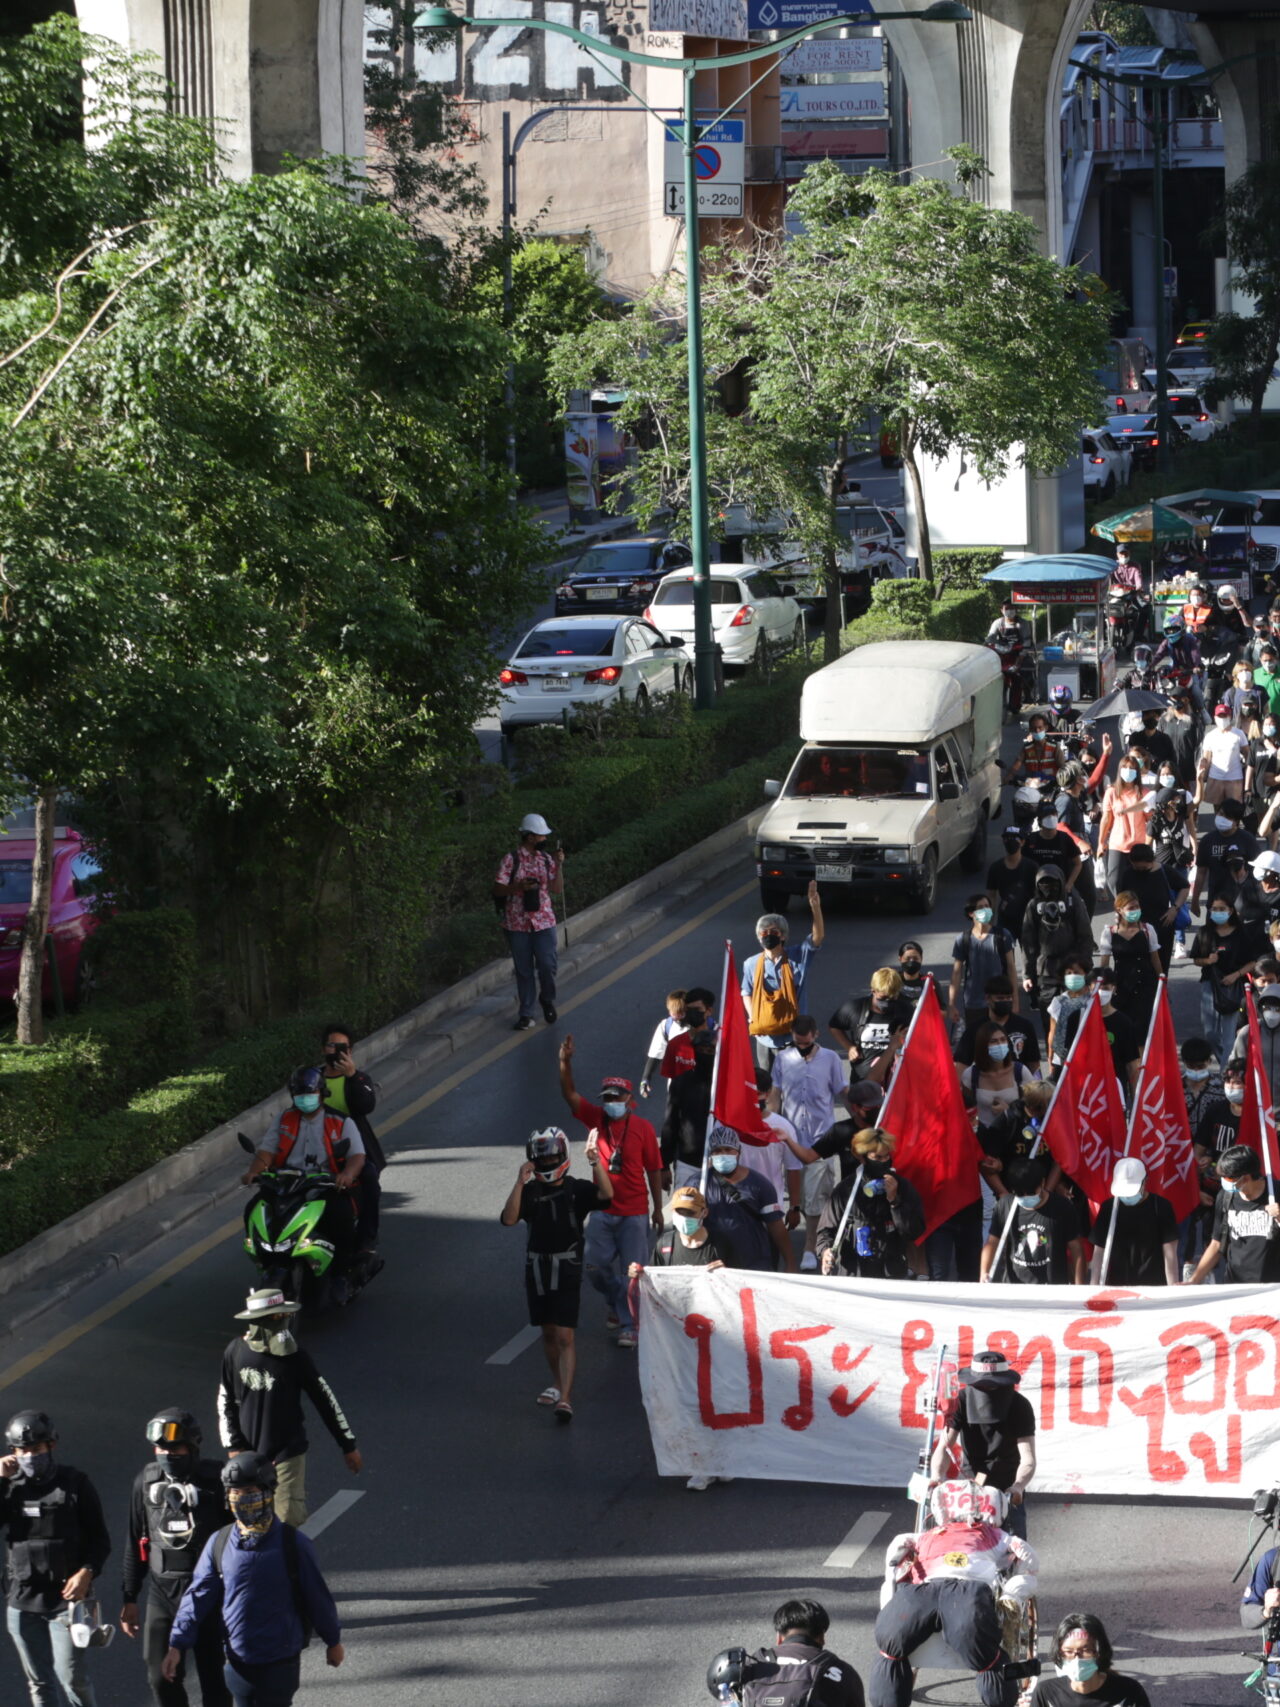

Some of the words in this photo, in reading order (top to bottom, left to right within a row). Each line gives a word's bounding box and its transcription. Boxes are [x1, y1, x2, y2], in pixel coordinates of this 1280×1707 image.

[781, 11, 833, 23] Bangkok
[838, 50, 872, 59] RENT
[806, 100, 838, 112] TOURS
